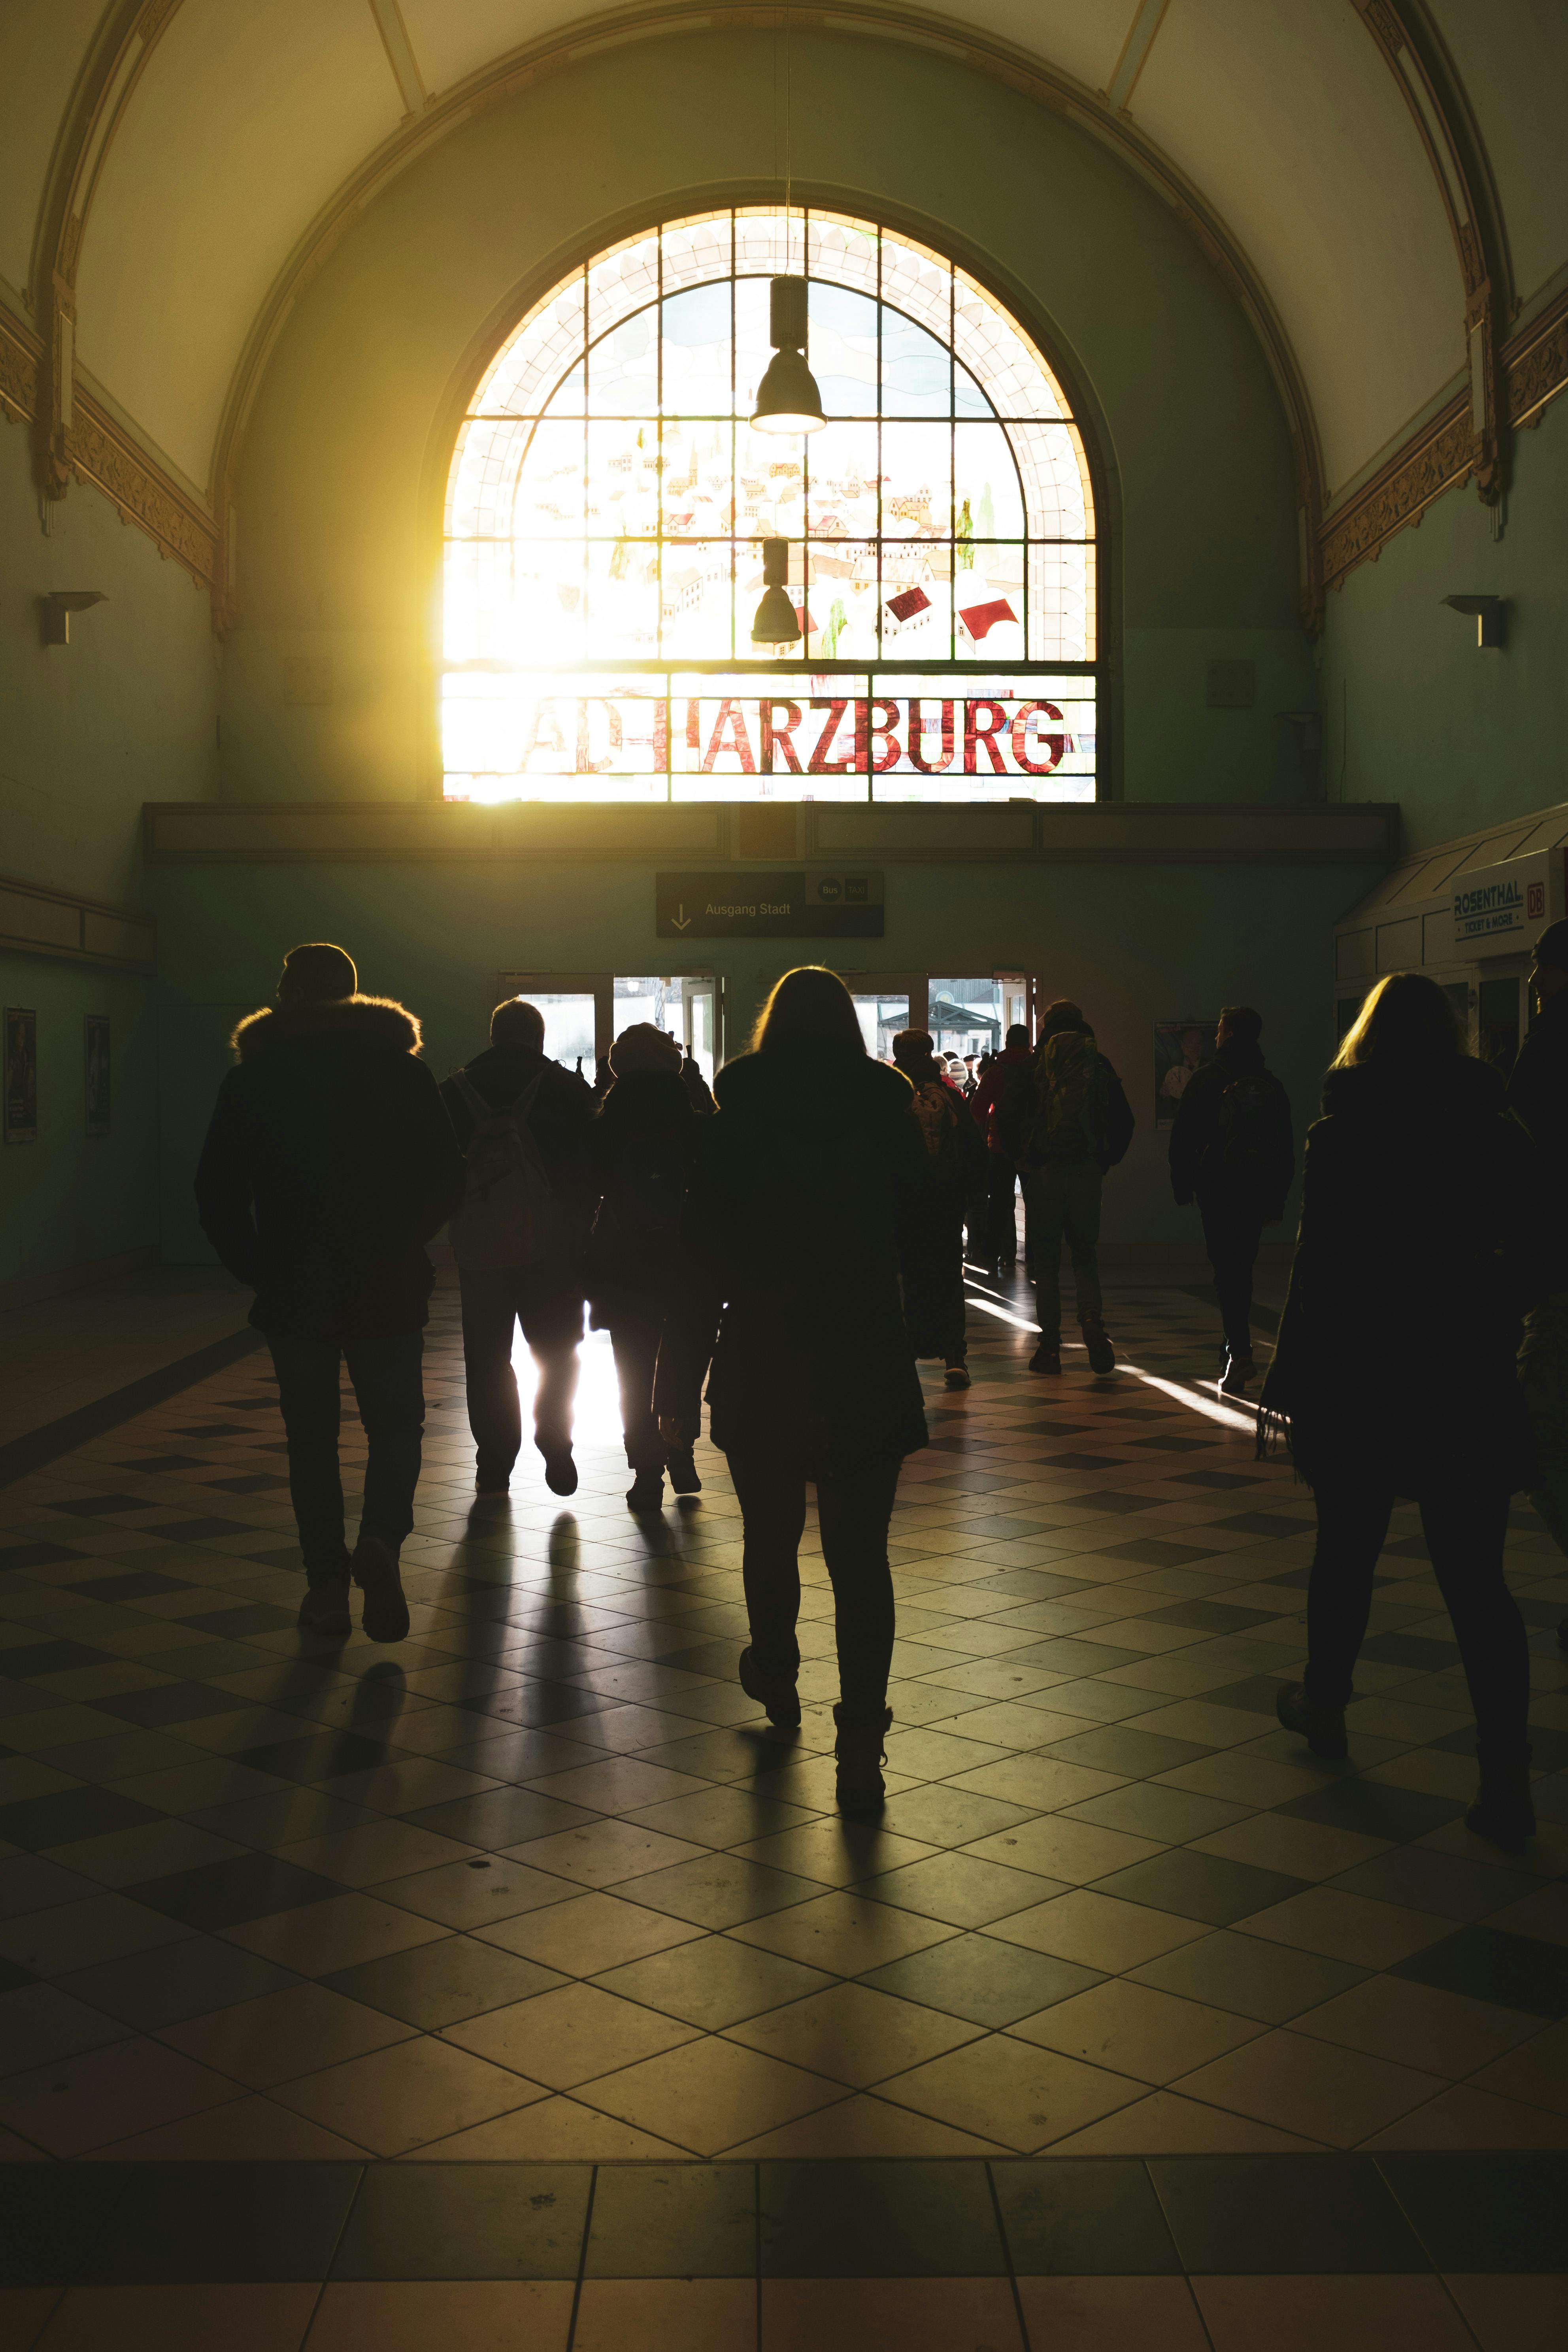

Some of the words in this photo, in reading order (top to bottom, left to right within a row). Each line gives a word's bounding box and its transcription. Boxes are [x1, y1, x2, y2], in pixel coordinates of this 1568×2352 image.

[516, 699, 623, 773] AD
[653, 699, 1064, 774] HARZBURG
[706, 904, 756, 917] Ausgang
[760, 903, 791, 914] Stadt
[1529, 888, 1542, 914] DB
[1464, 919, 1485, 933] TICKET
[1492, 913, 1513, 928] MORE
